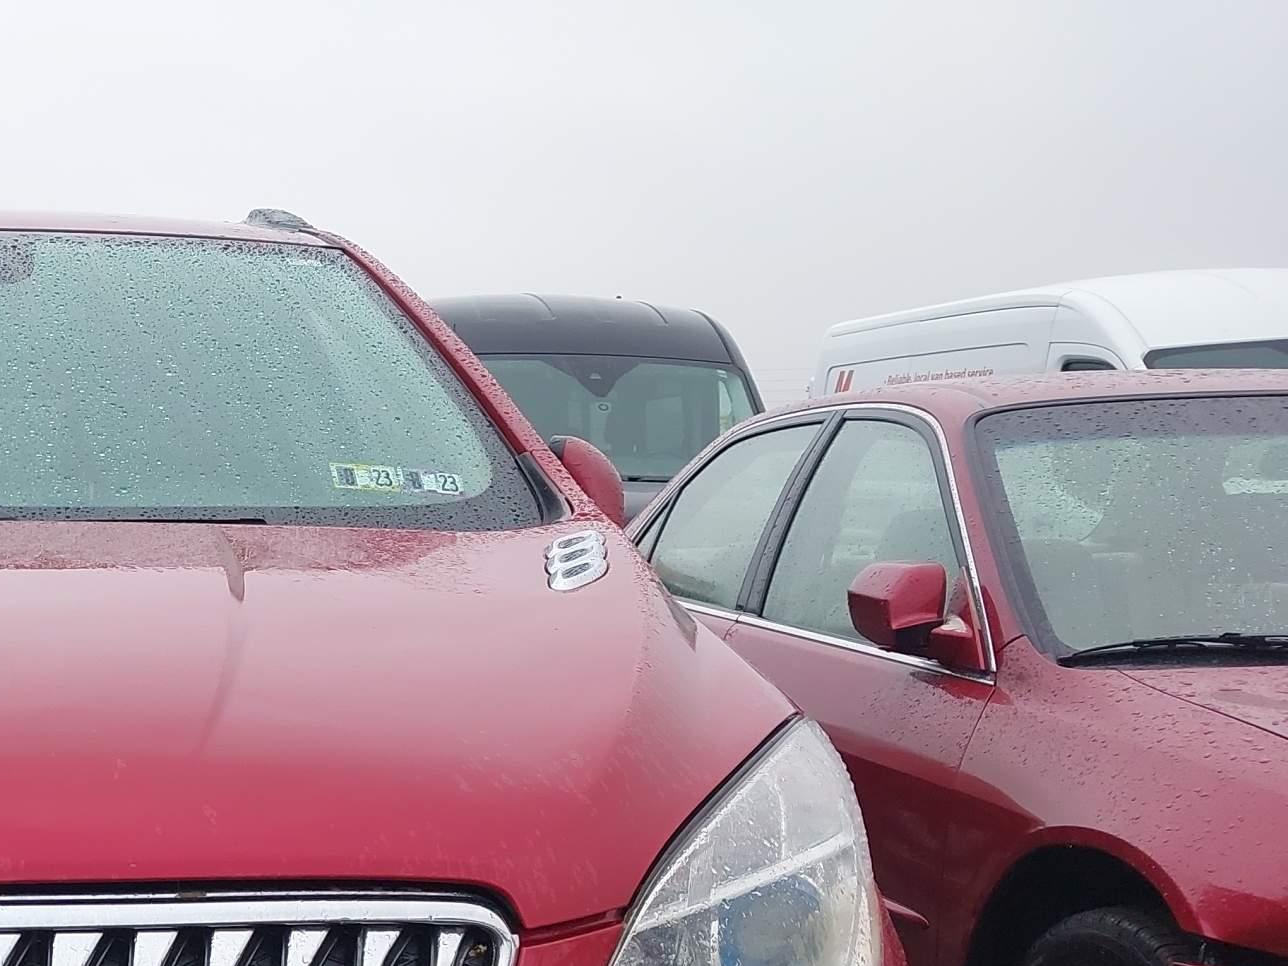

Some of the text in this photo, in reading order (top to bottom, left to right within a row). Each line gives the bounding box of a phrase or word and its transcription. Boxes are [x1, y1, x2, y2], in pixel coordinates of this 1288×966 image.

[931, 372, 943, 381] van
[372, 469, 393, 487] 23
[439, 474, 459, 492] 23
